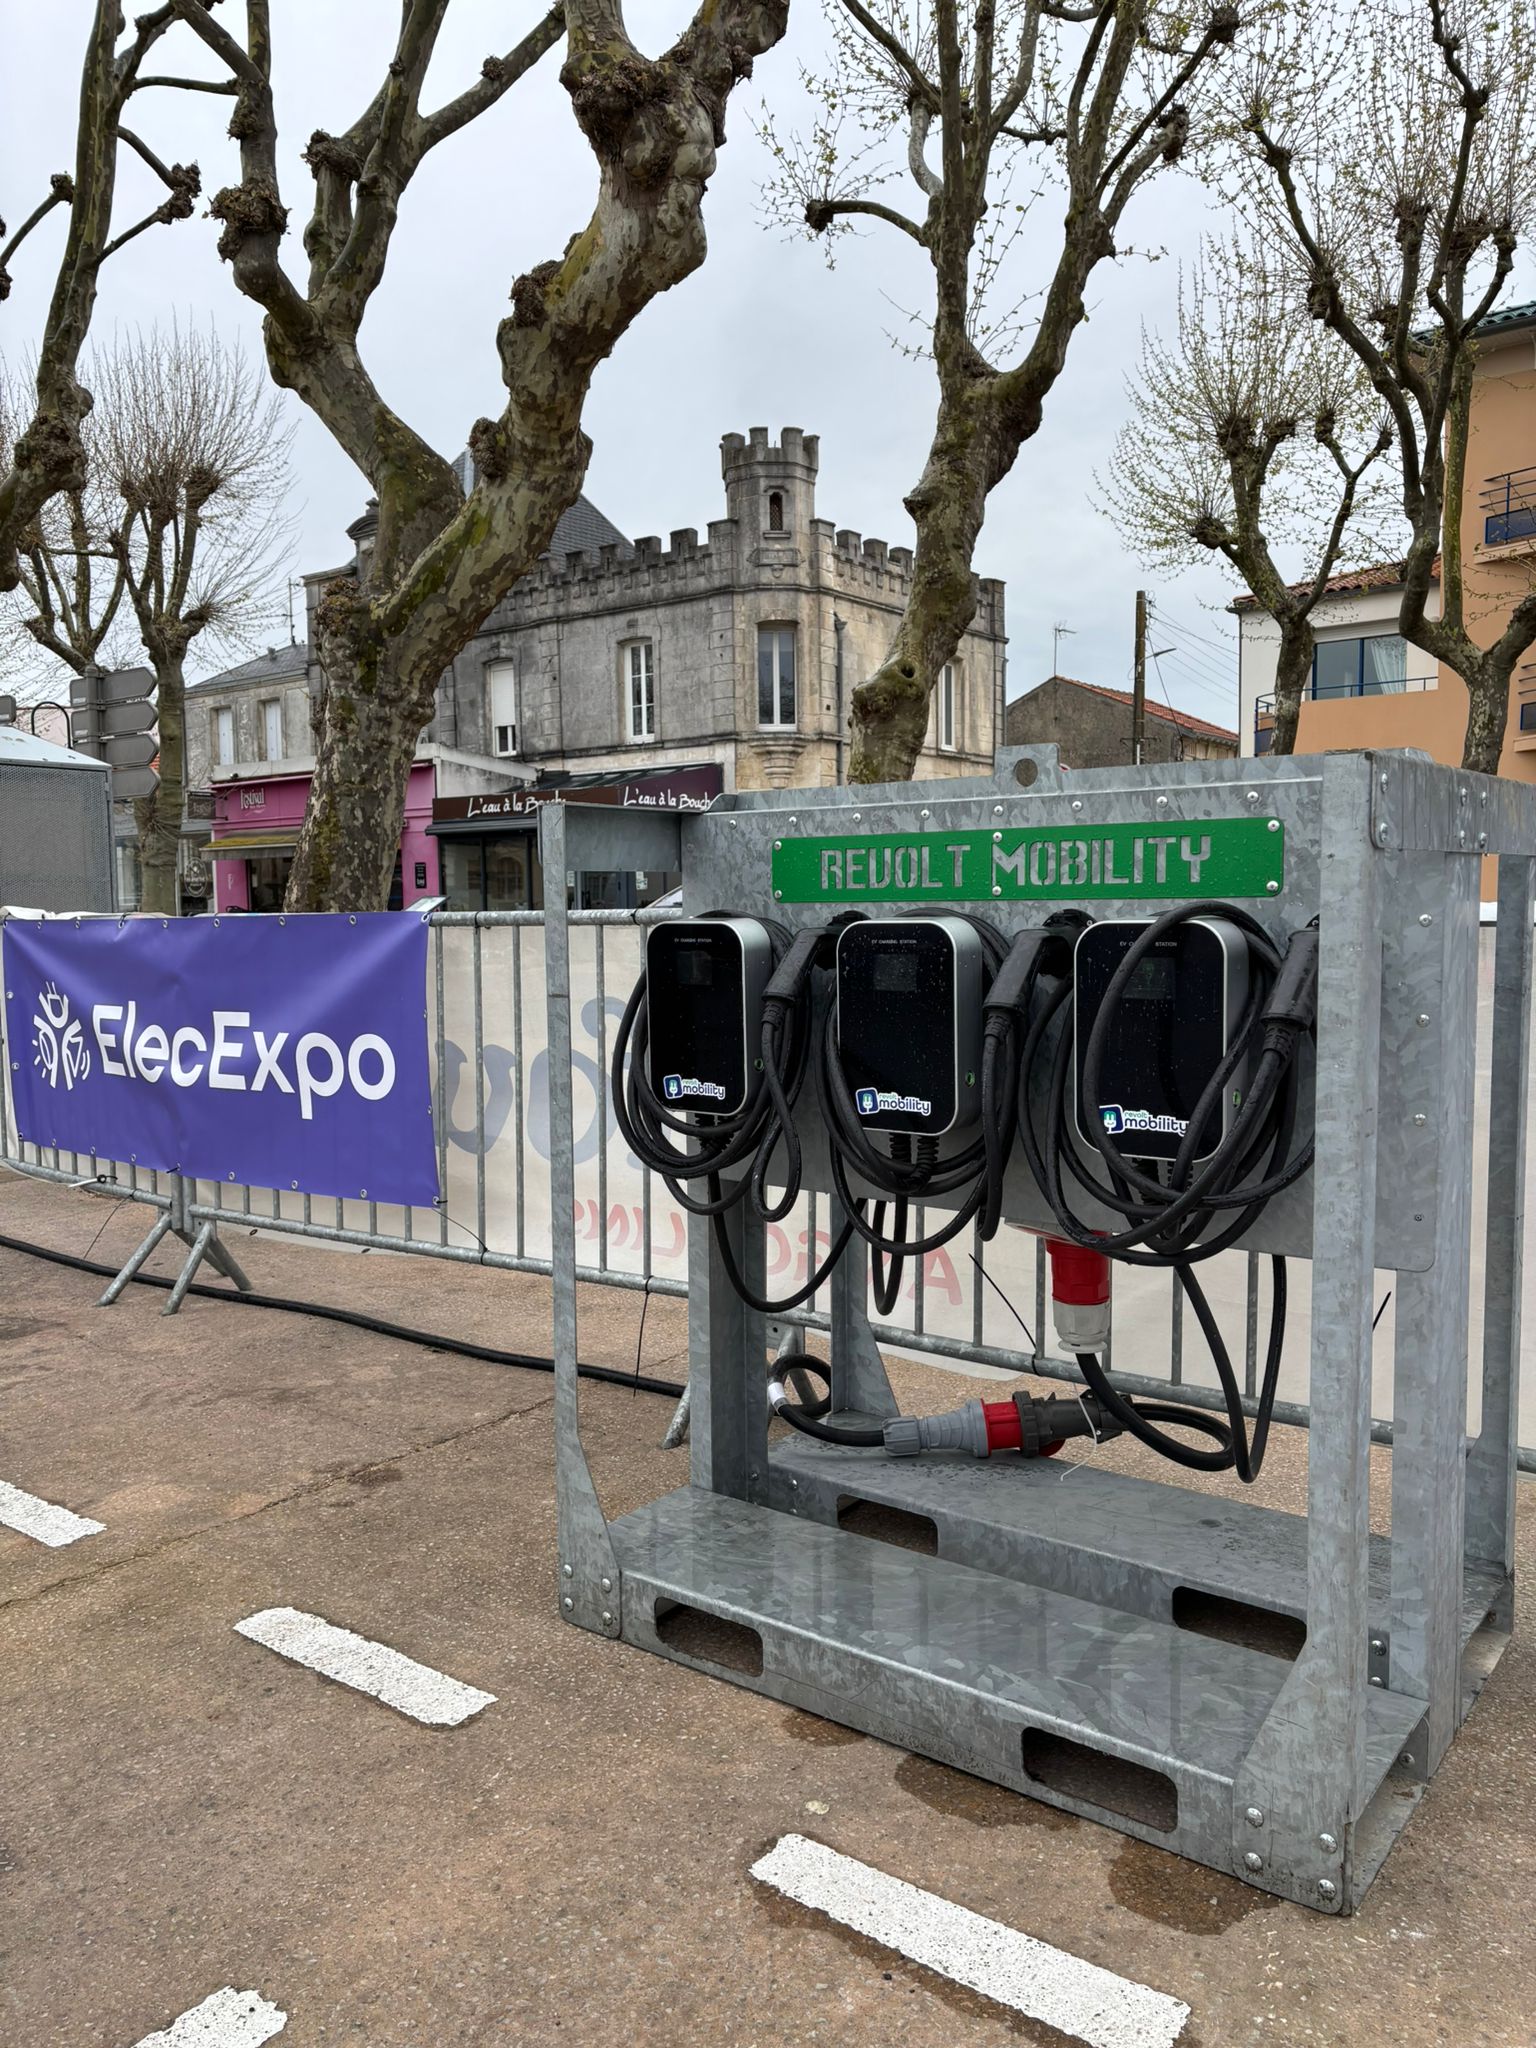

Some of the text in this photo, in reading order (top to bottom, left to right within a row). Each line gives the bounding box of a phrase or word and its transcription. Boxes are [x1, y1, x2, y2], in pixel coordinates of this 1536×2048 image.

[467, 797, 501, 818] L'eau
[503, 797, 511, 812] à
[513, 793, 523, 812] la
[624, 786, 712, 811] L'eau à la Bouch
[821, 835, 1212, 889] REVOLT MOBILITY
[92, 1000, 396, 1121] ElecExpo
[683, 1083, 725, 1099] mobility
[879, 1096, 930, 1115] mobility
[1124, 1111, 1148, 1119] revolt
[1125, 1115, 1188, 1136] mobility
